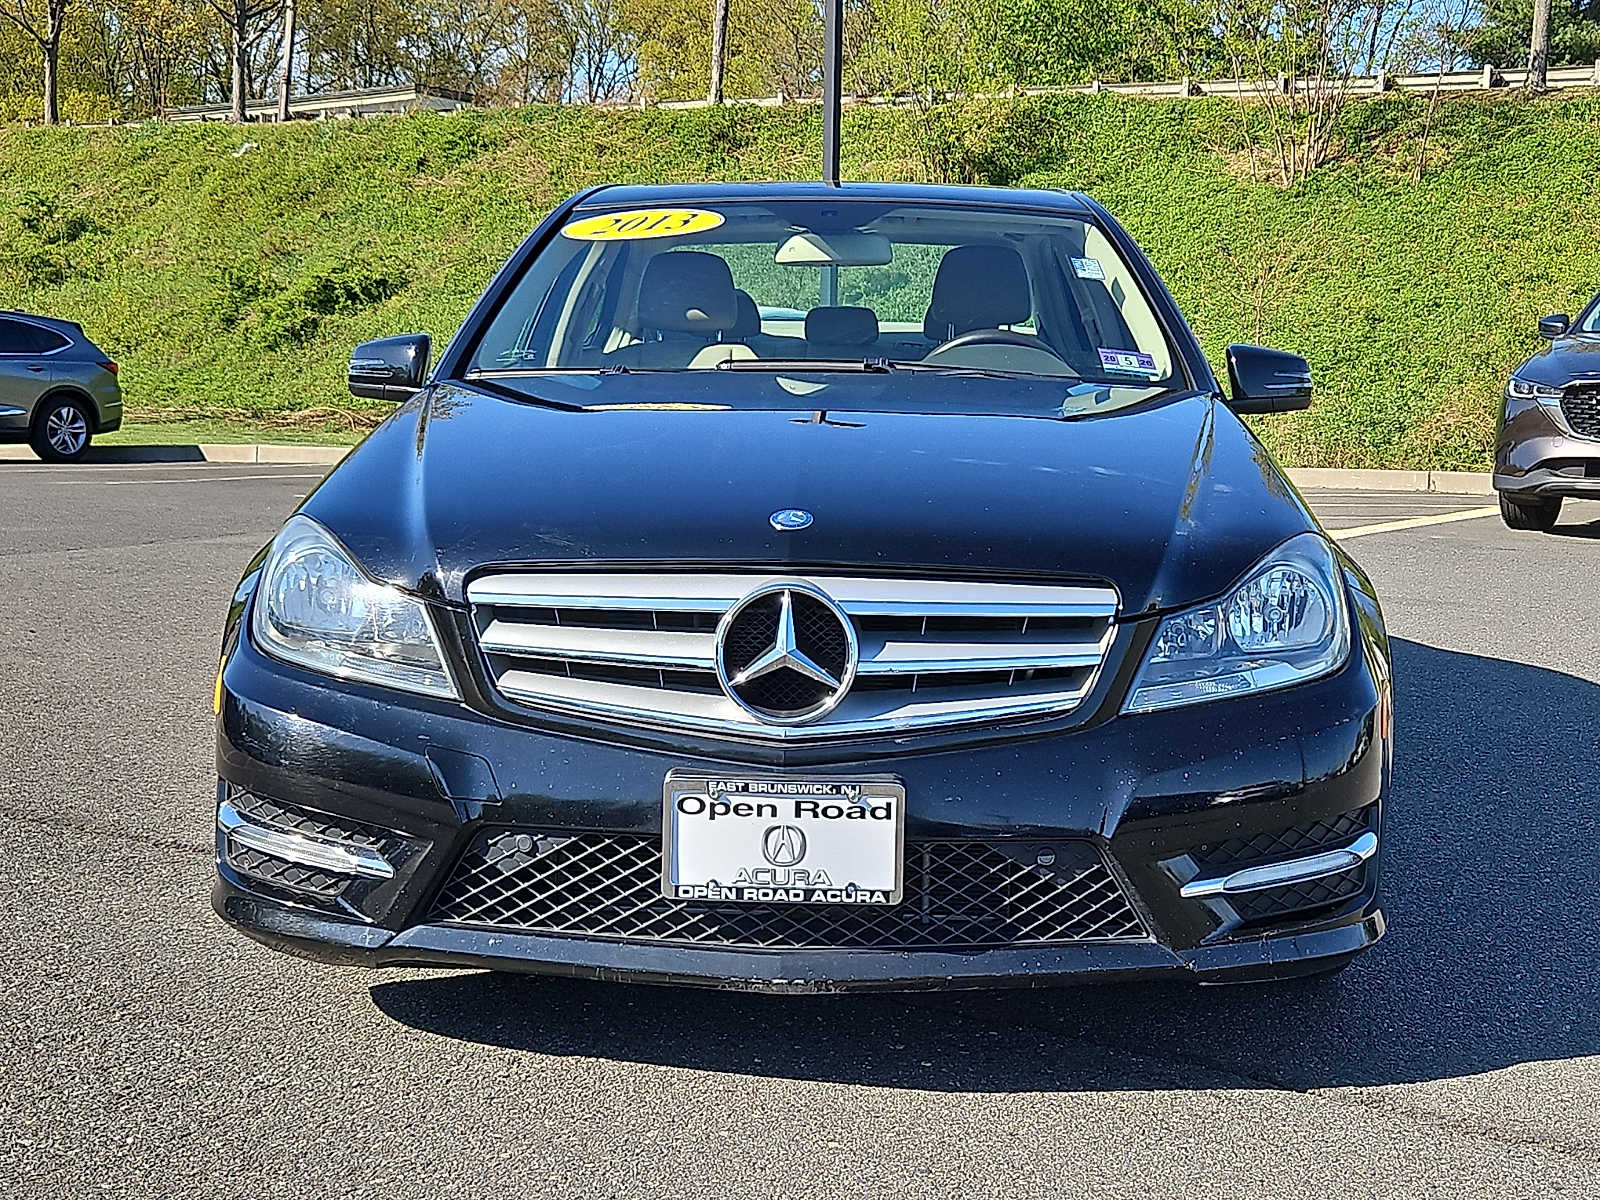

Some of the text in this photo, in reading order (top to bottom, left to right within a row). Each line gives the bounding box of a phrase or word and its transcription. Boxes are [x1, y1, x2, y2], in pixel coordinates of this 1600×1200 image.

[589, 213, 699, 236] 2013
[1124, 356, 1133, 366] 5
[708, 781, 745, 793] EAST
[748, 783, 837, 795] BRUNSWICK,
[677, 796, 892, 821] Open Road
[732, 867, 832, 886] ACURA
[678, 885, 887, 904] OPEN ROAD ACURA
